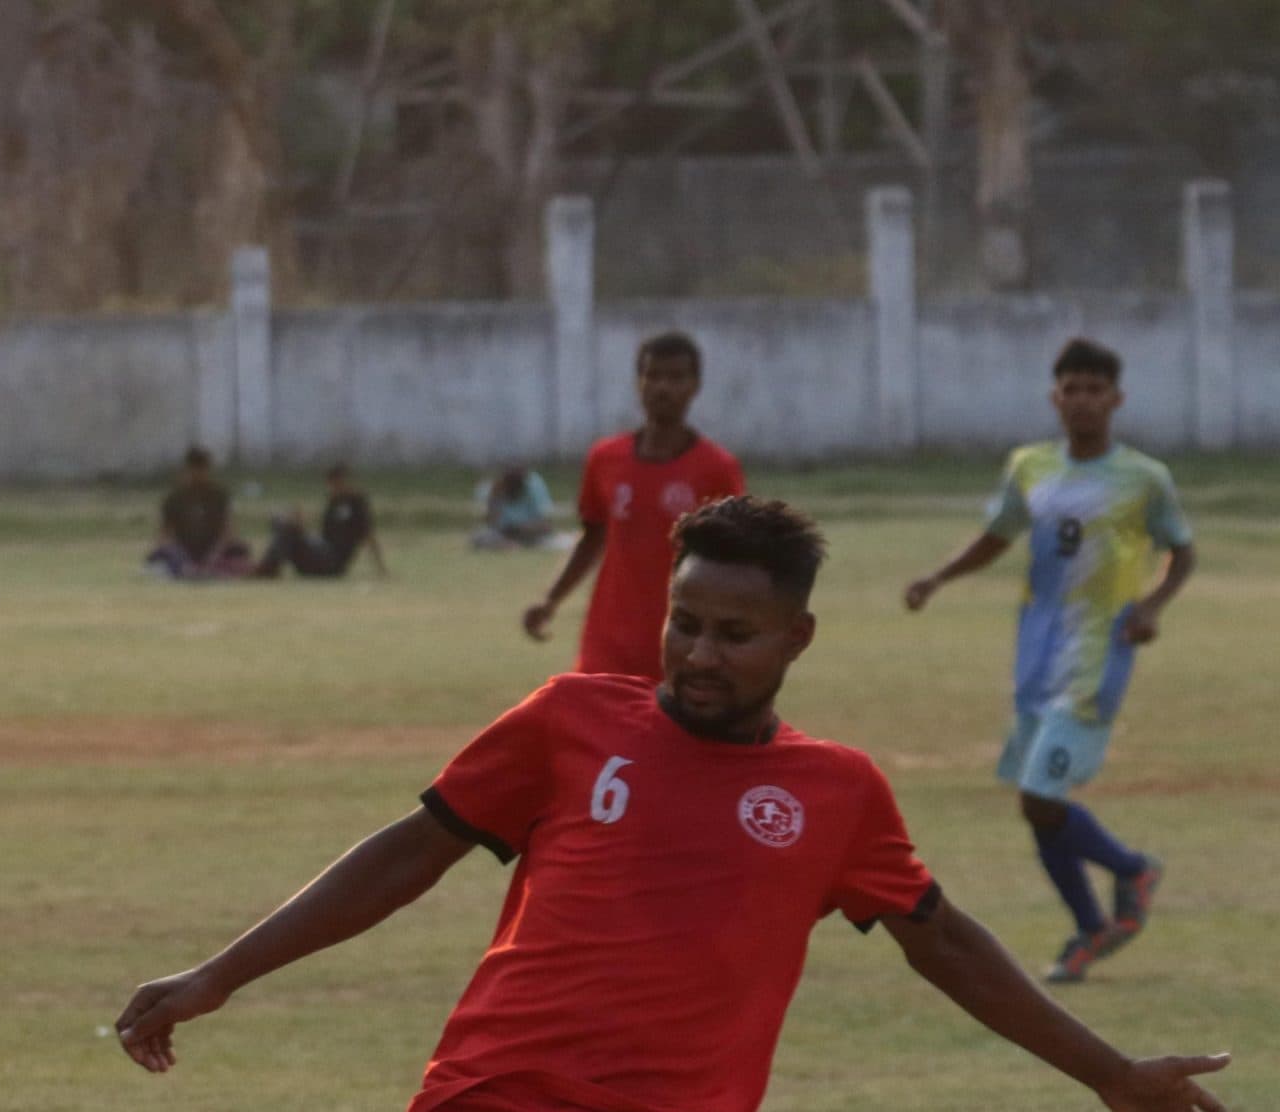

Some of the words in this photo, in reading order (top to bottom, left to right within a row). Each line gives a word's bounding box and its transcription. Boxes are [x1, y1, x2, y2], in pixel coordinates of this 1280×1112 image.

[609, 482, 632, 519] 2
[1057, 516, 1083, 557] 9
[1047, 747, 1071, 781] 9
[590, 754, 634, 825] 6
